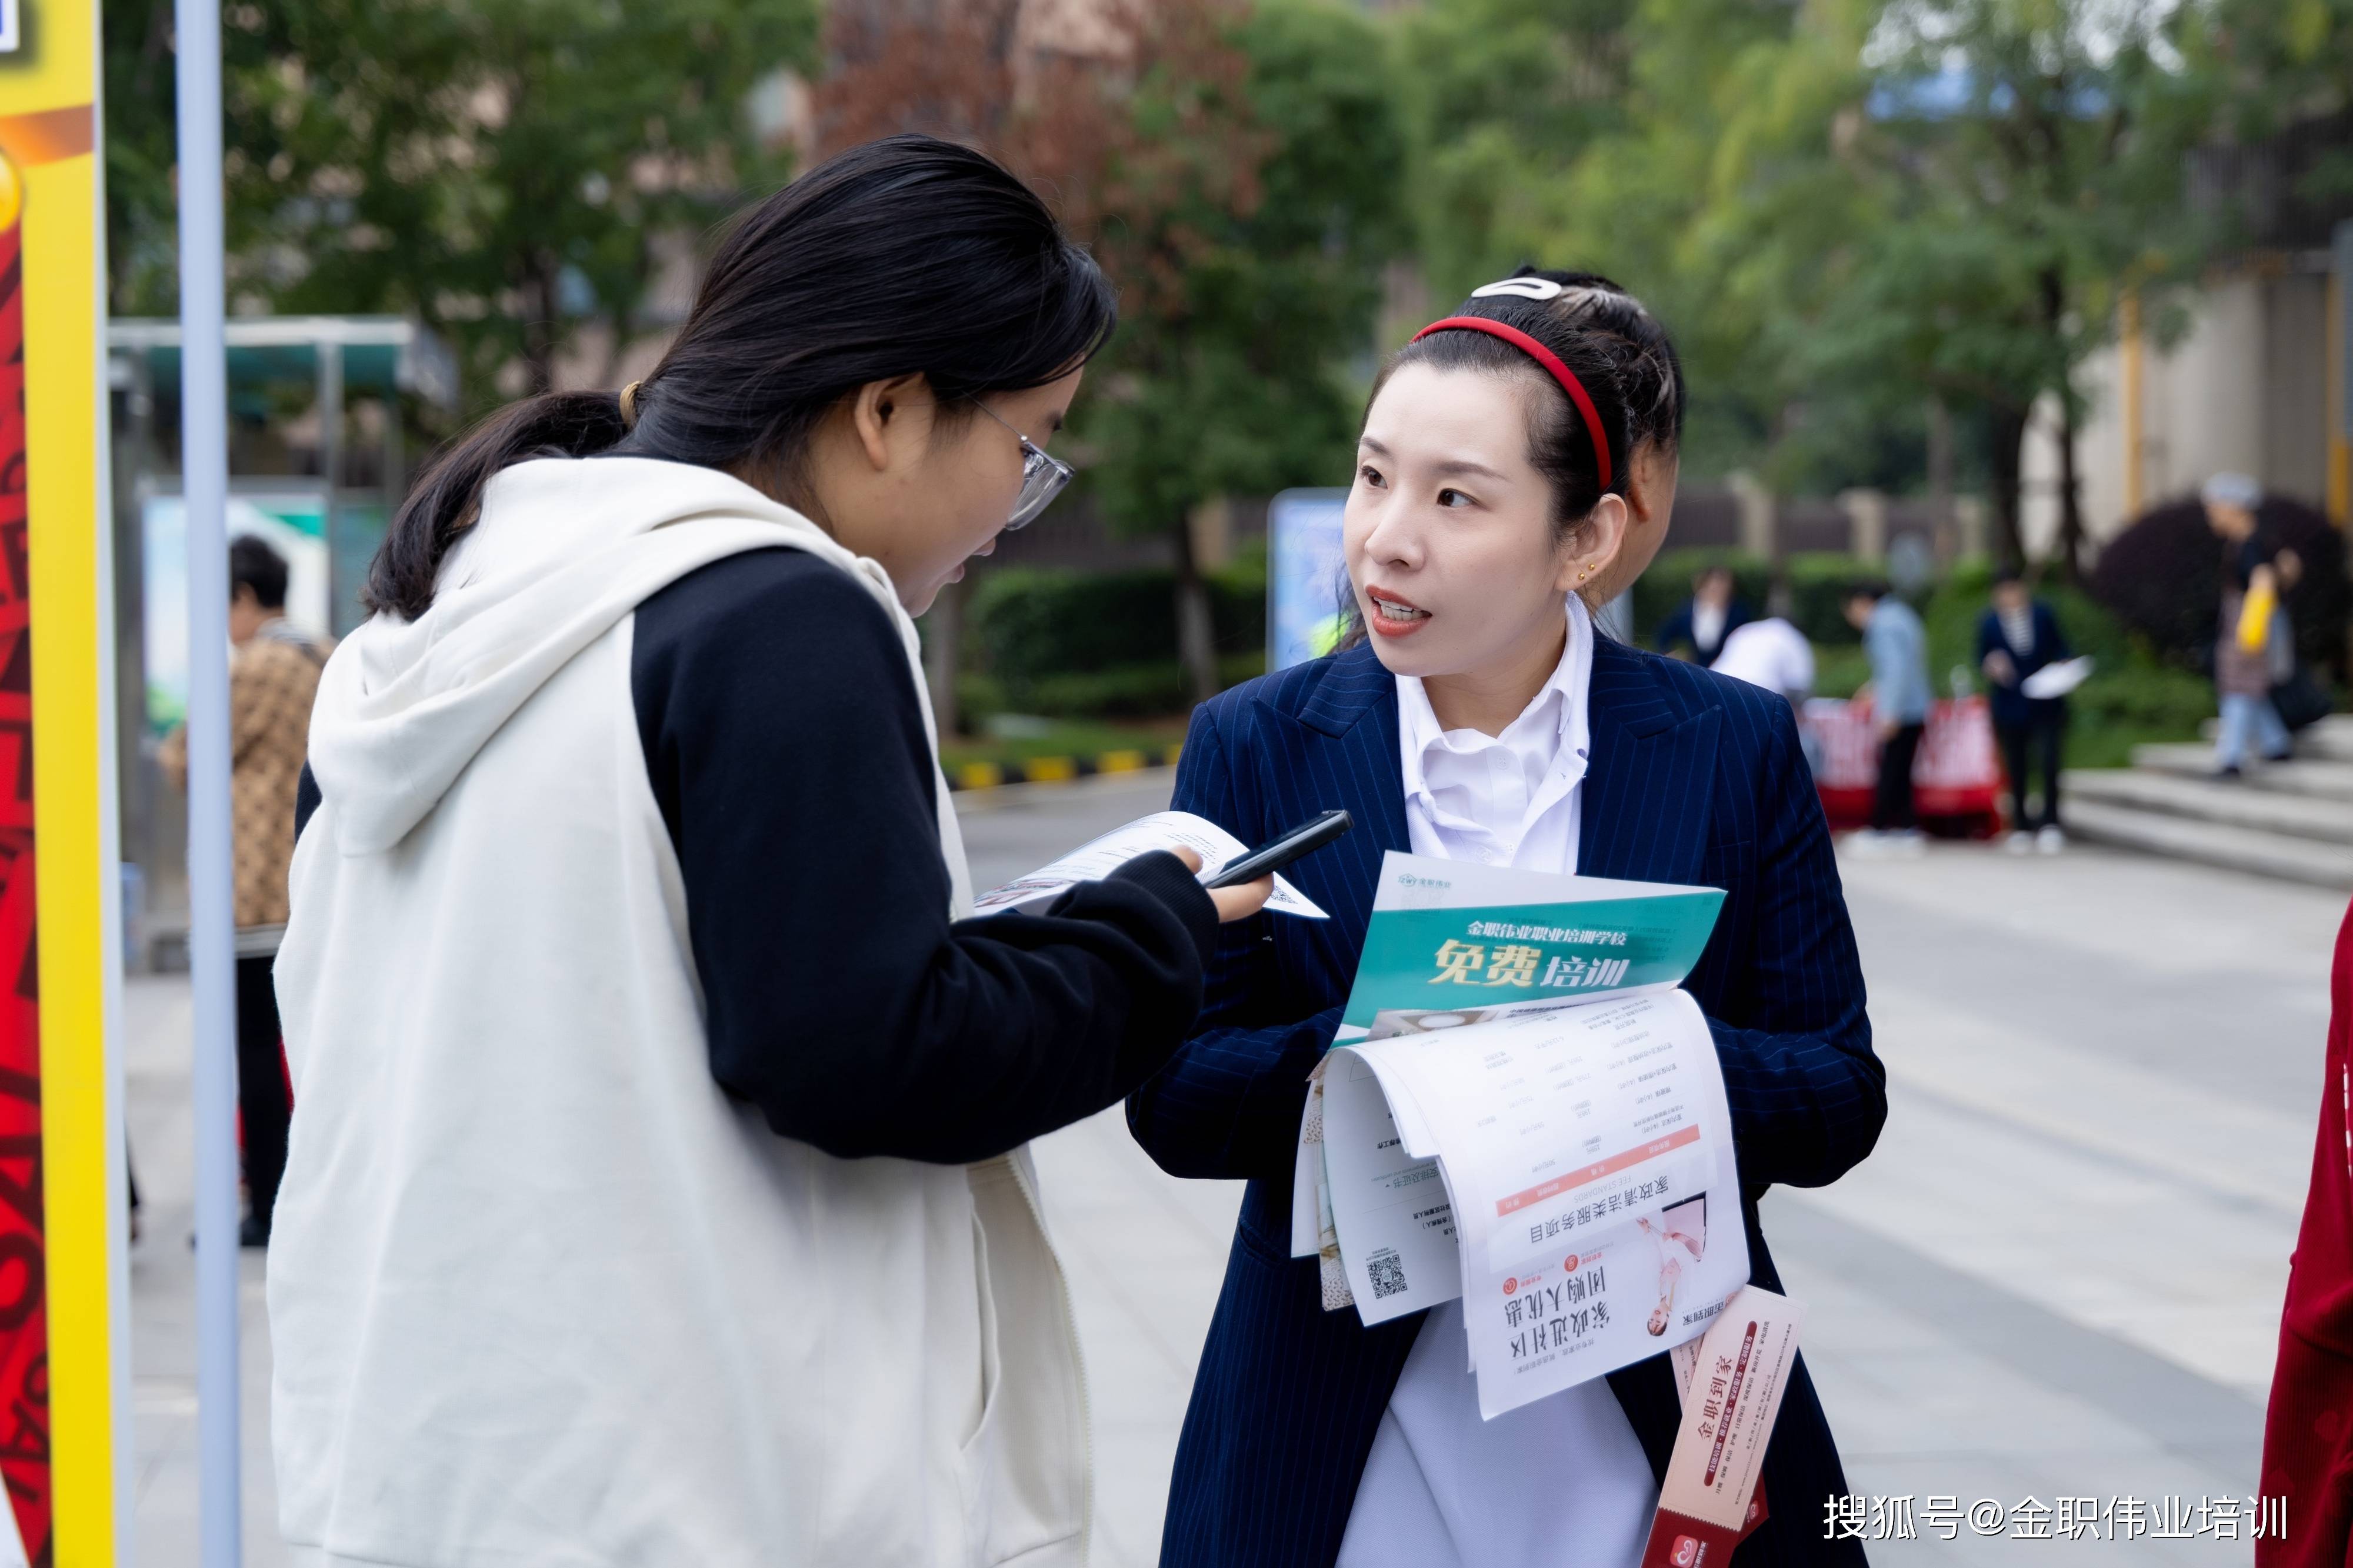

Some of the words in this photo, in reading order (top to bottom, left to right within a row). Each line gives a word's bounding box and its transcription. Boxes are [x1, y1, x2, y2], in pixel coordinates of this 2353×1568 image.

[1466, 920, 1628, 946] 金职伟业职业培训学校
[1428, 939, 1542, 987] 免费
[1540, 955, 1631, 987] 培训
[1572, 1180, 1617, 1203] STANDARDS
[1617, 1174, 1632, 1186] FEE
[1529, 1175, 1669, 1243] 家政清洁类服务项目
[1504, 1265, 1605, 1328] 团购大优惠
[1682, 1301, 1723, 1326] 金职到家
[1507, 1300, 1611, 1361] 家政进社区
[1695, 1354, 1734, 1442] 金职到家
[1724, 1449, 1734, 1462] 保洁
[1729, 1432, 1738, 1446] 护理
[1734, 1404, 1747, 1429] 日常保洁
[1742, 1376, 1754, 1402] 深度保洁
[1749, 1348, 1762, 1373] 新房开荒
[1758, 1319, 1771, 1345] 家电清洗
